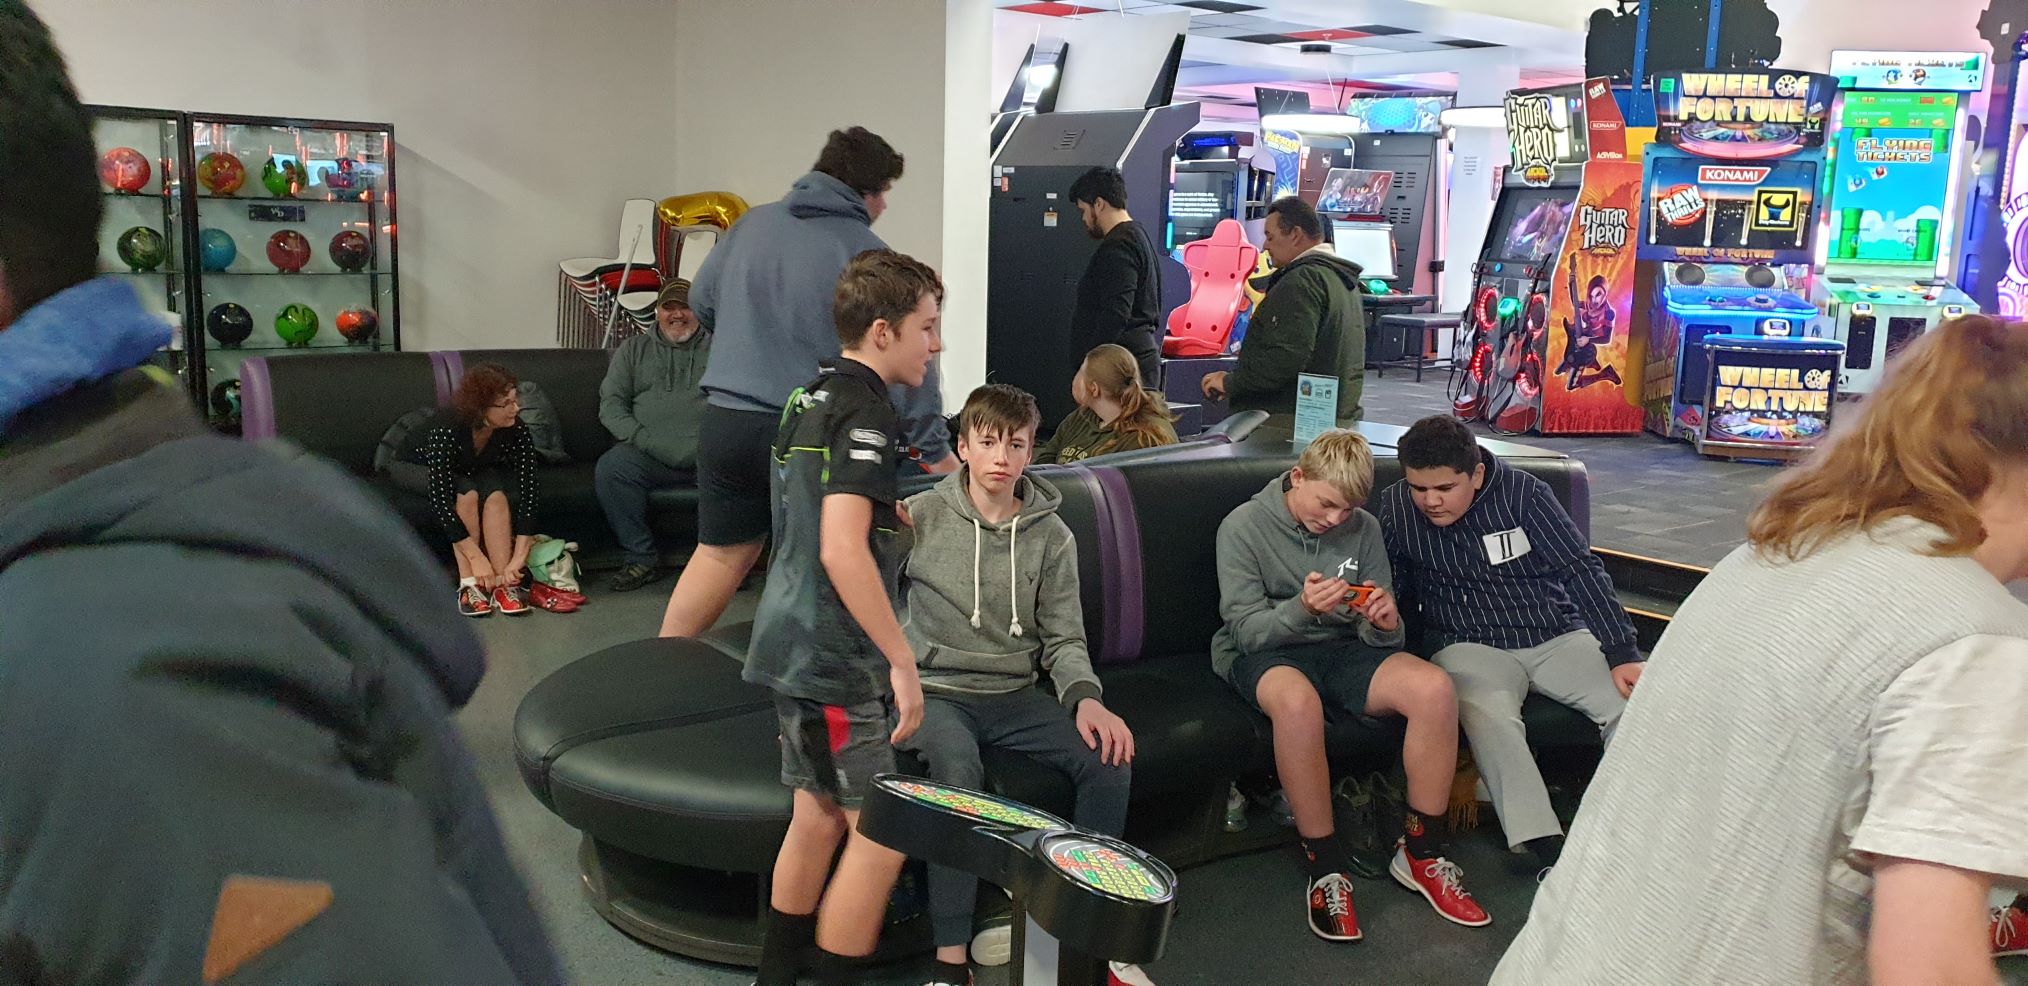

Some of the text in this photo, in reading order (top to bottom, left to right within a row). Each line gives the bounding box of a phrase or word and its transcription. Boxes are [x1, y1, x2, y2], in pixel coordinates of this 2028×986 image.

[1682, 73, 1773, 97] WHEEL
[1679, 97, 1808, 123] FORTUNE
[1856, 139, 1932, 151] FLYING
[1856, 151, 1931, 162] TICKETS
[1706, 169, 1758, 181] KONAMI
[1659, 185, 1700, 214] RAW
[1718, 366, 1803, 389] WHEEL
[1716, 386, 1828, 412] FORTUNE
